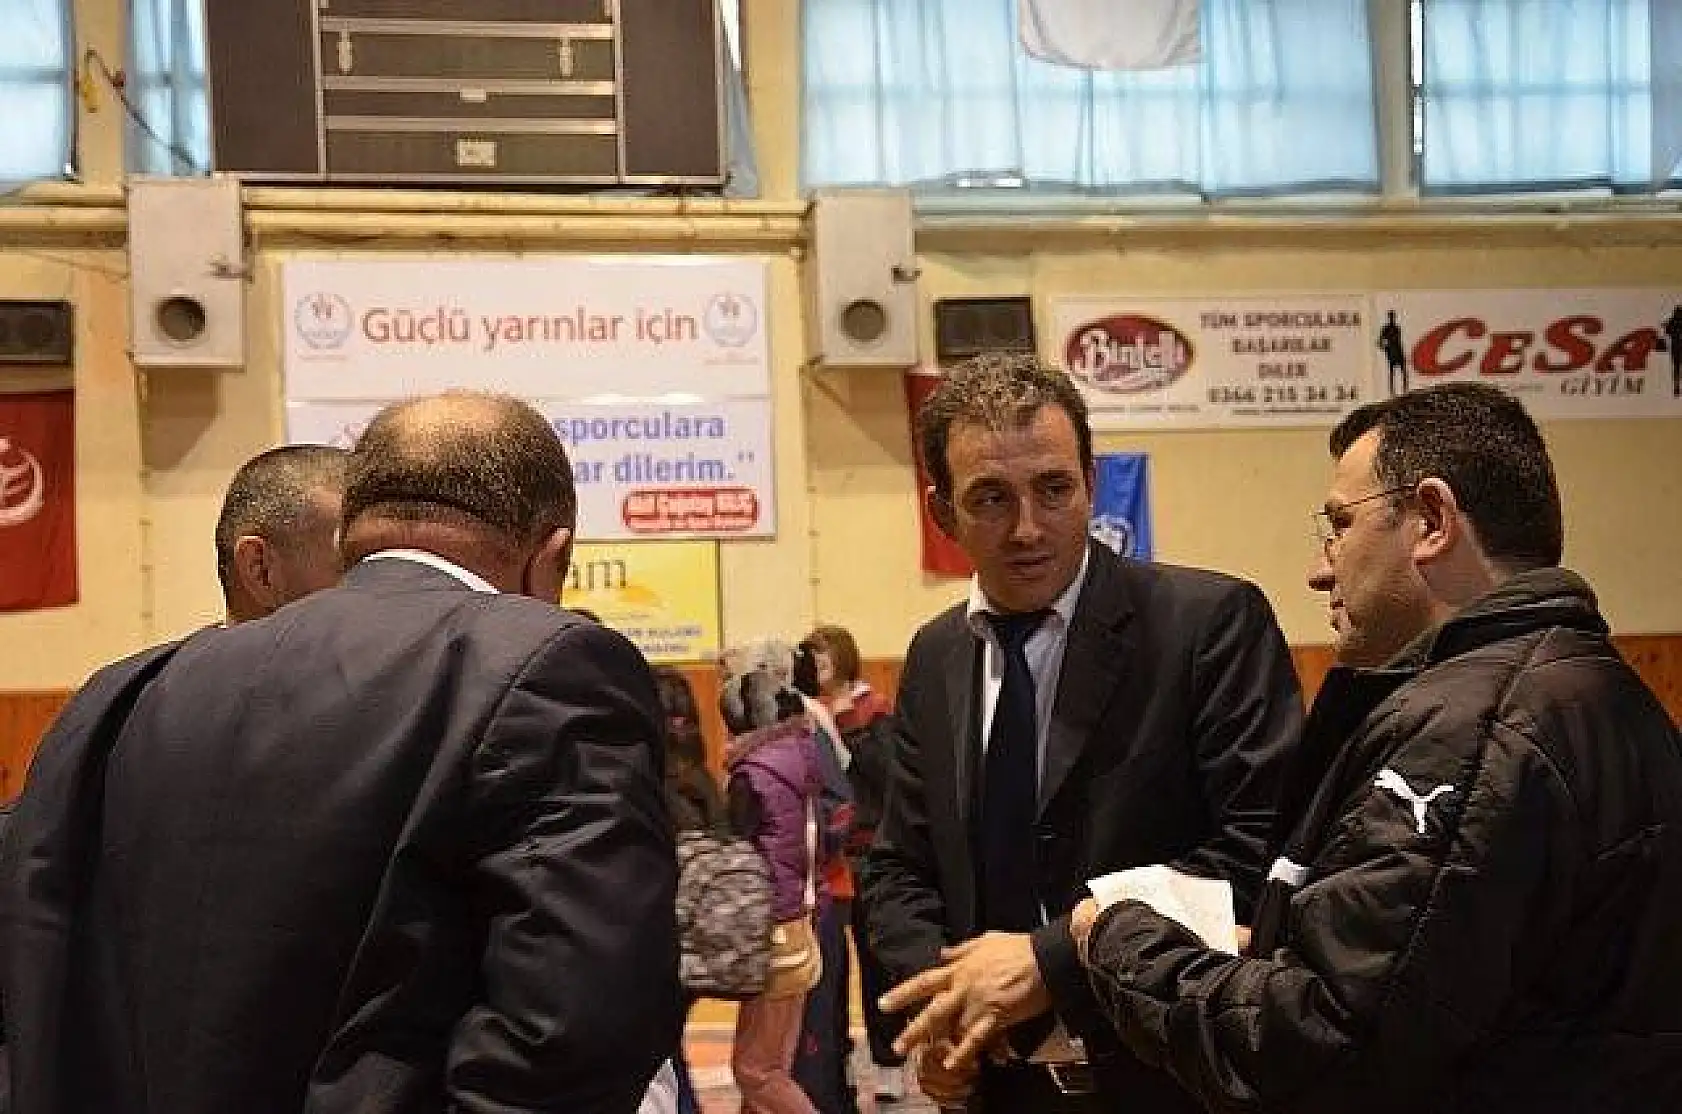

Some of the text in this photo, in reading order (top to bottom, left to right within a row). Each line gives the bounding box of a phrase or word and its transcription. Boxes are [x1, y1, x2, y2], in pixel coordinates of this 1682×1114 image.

[362, 305, 699, 351] Güçlü yarınlar için
[553, 411, 725, 446] sporculara
